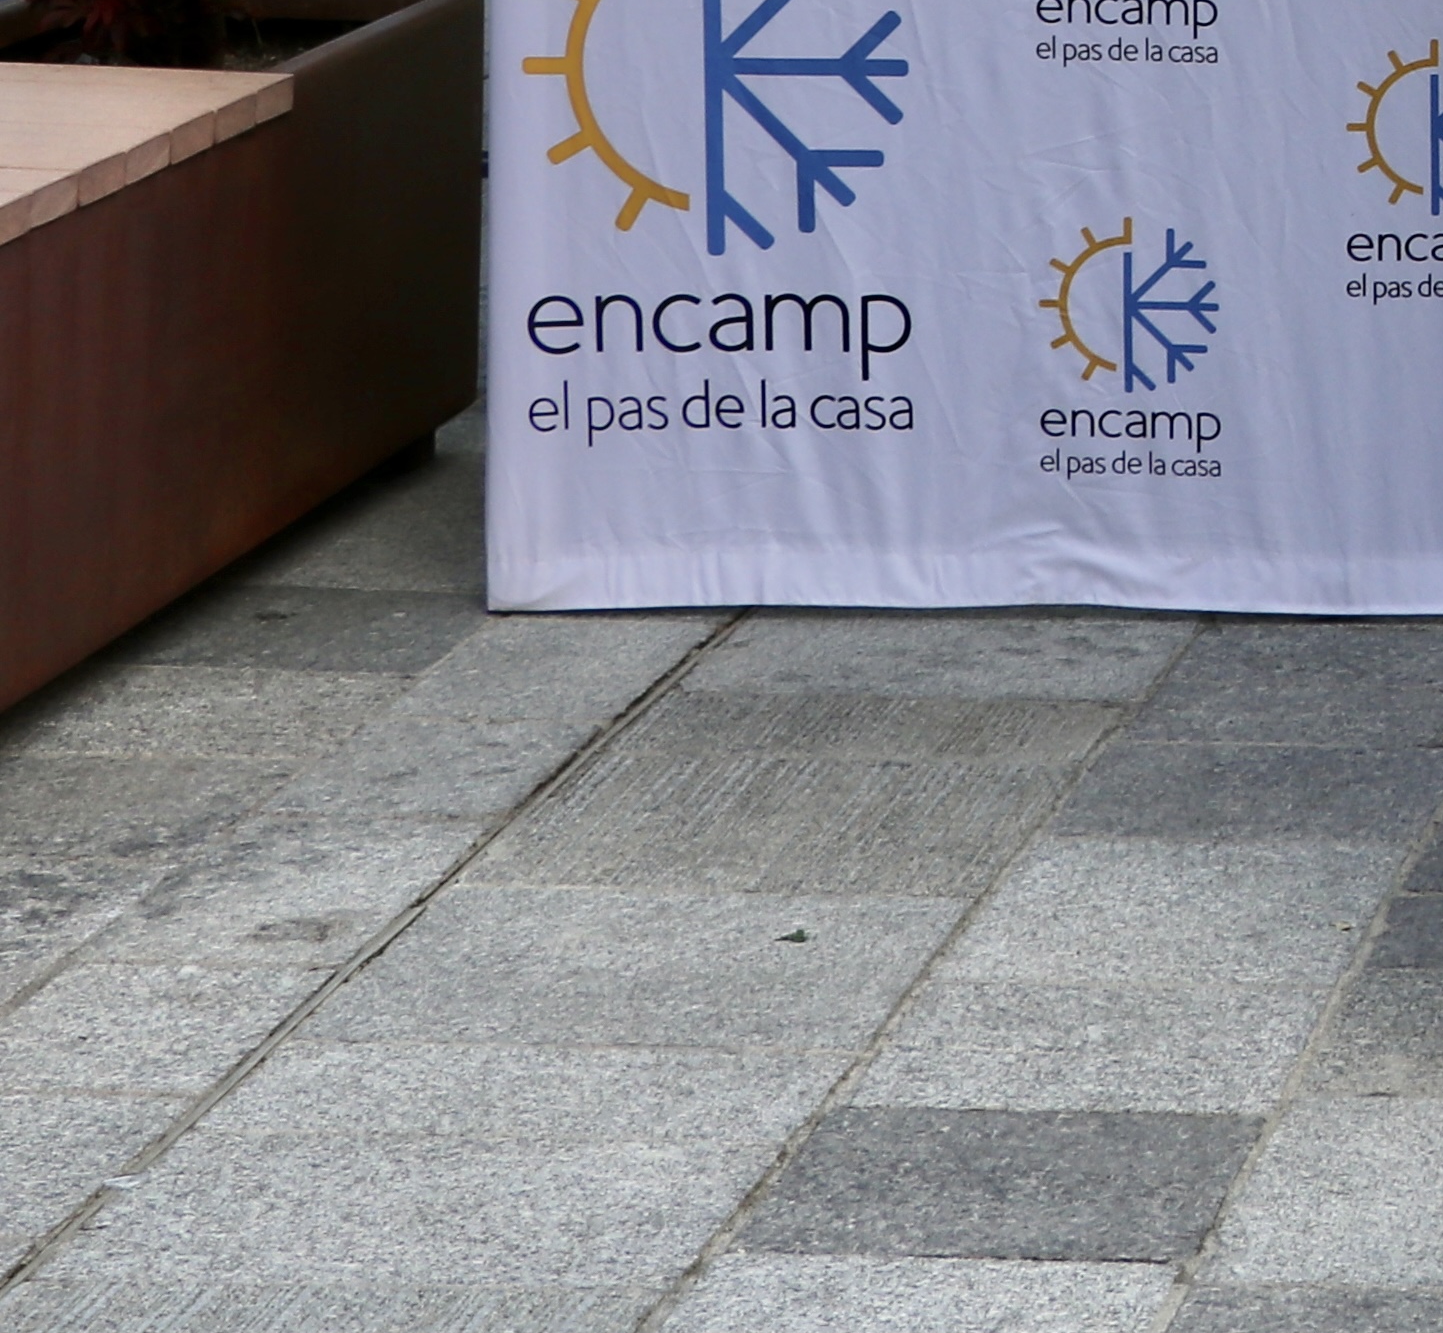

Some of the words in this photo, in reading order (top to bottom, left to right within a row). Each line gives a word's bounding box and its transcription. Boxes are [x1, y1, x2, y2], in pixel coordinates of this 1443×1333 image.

[1035, 35, 1056, 60] el
[1062, 43, 1103, 68] pas
[1107, 36, 1139, 62] de
[1145, 37, 1163, 62] la
[1167, 45, 1219, 64] casa
[1346, 272, 1367, 298] el
[1373, 280, 1413, 306] pas
[527, 292, 912, 382] encamp
[528, 380, 569, 433] el
[587, 395, 669, 448] pas
[681, 378, 745, 429] de
[760, 378, 797, 430] la
[809, 394, 914, 431] casa
[1039, 408, 1222, 454] encamp
[1039, 447, 1060, 473] el
[1066, 455, 1107, 481] pas
[1111, 450, 1143, 475] de
[1148, 450, 1166, 476] la
[1171, 459, 1222, 478] casa
